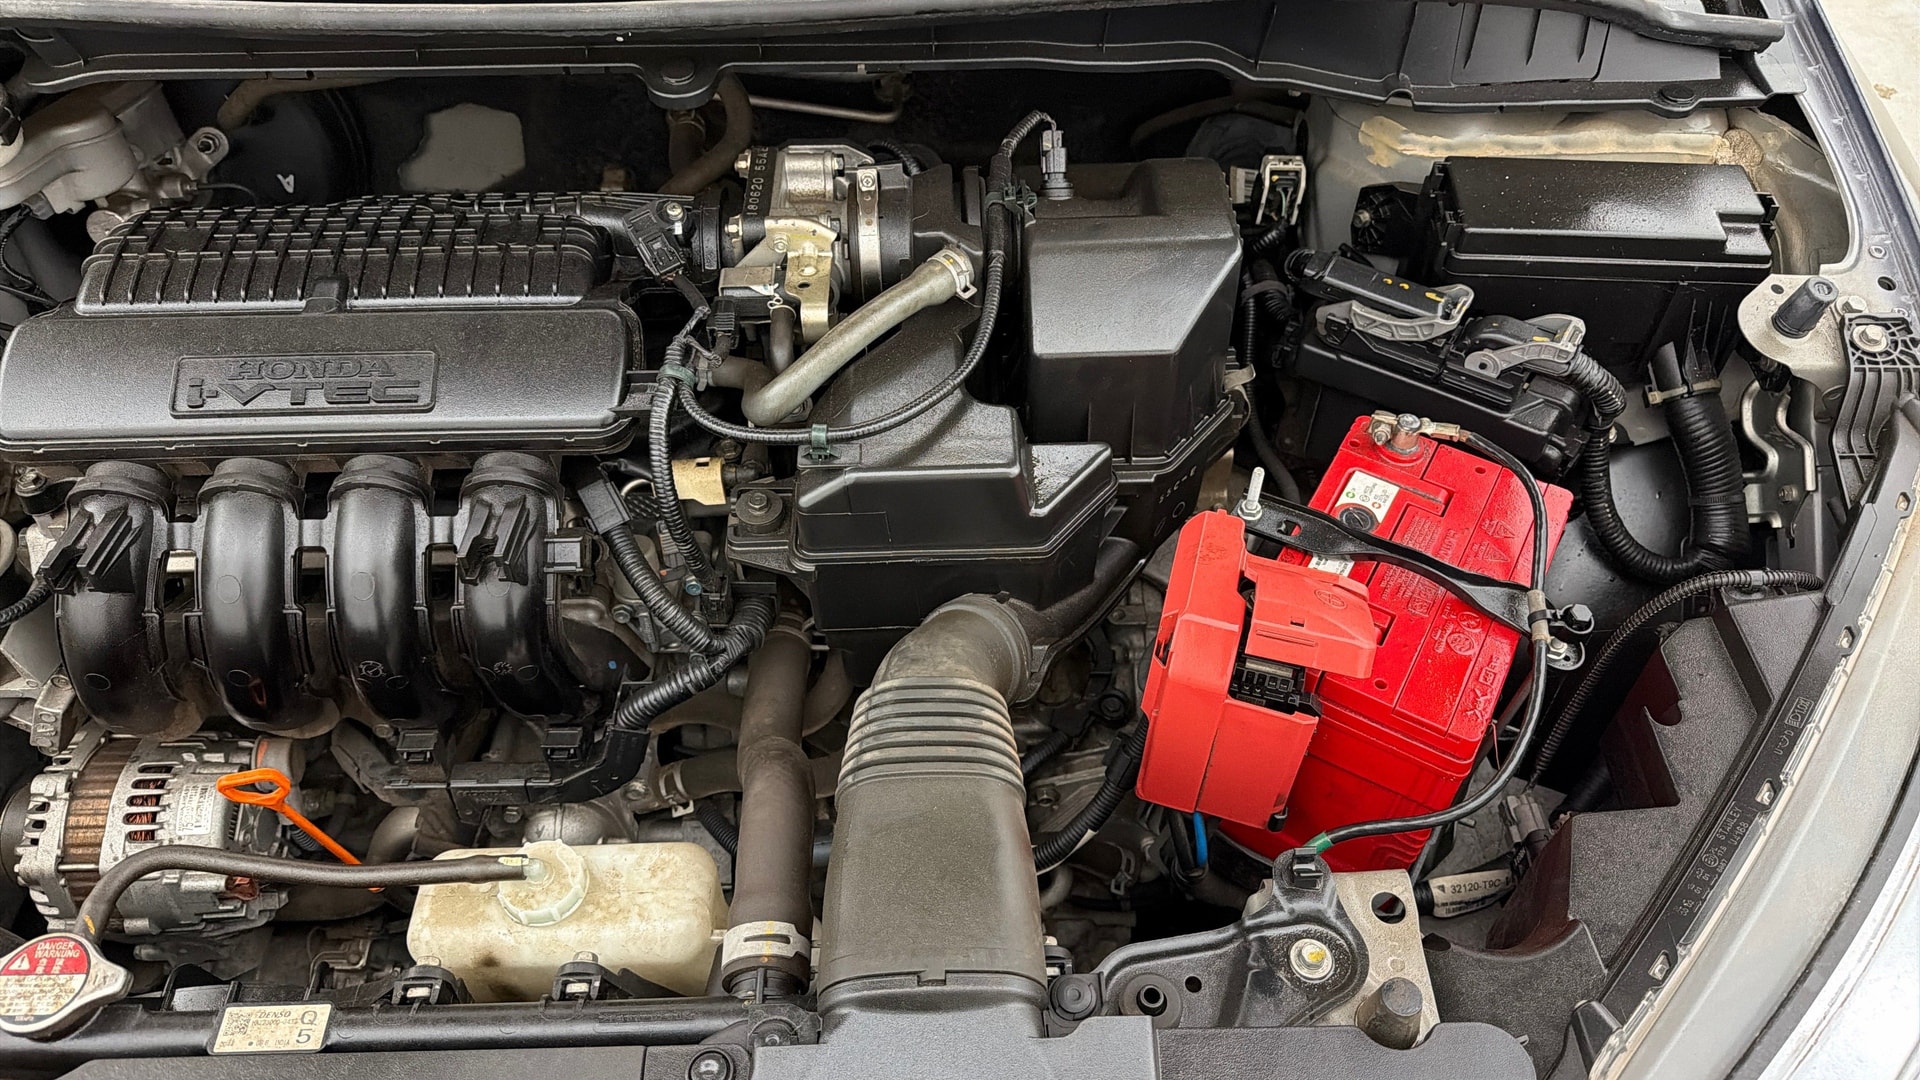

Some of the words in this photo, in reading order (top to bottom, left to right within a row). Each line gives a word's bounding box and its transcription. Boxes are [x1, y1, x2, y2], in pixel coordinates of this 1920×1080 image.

[746, 177, 764, 215] 180620
[228, 358, 396, 381] HONDA
[186, 377, 421, 409] i-VTEC
[1716, 806, 1742, 840] STANLEY
[37, 941, 76, 950] DANGER
[34, 949, 81, 959] WARNUNG
[258, 1010, 292, 1019] DENSO
[300, 1010, 318, 1026] Q
[295, 1028, 313, 1044] 5
